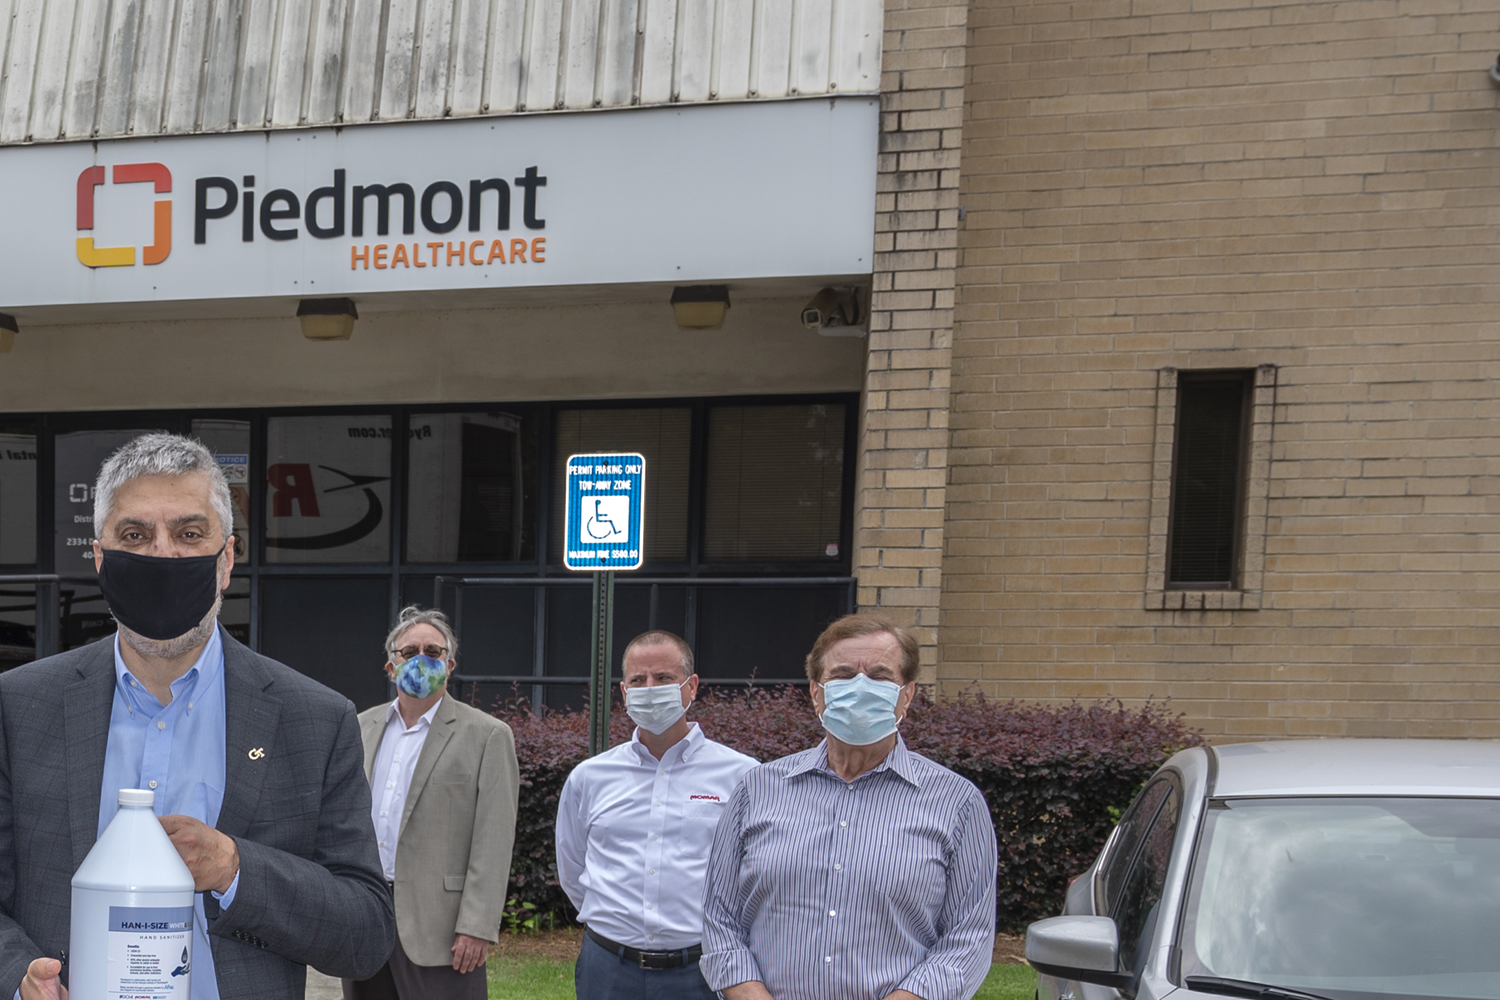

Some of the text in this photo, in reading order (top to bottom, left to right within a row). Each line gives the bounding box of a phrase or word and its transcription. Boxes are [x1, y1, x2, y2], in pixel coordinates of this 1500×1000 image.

[194, 165, 547, 244] Piedmont
[350, 236, 547, 270] HEALTHCARE
[569, 464, 642, 475] PERMIT PARKING ONLY
[579, 480, 632, 490] TOW-AWAY ZONE
[66, 538, 87, 546] 2334
[568, 549, 638, 558] MAXIMUM FINE $500.00
[121, 921, 169, 930] HAN-I-SIZE
